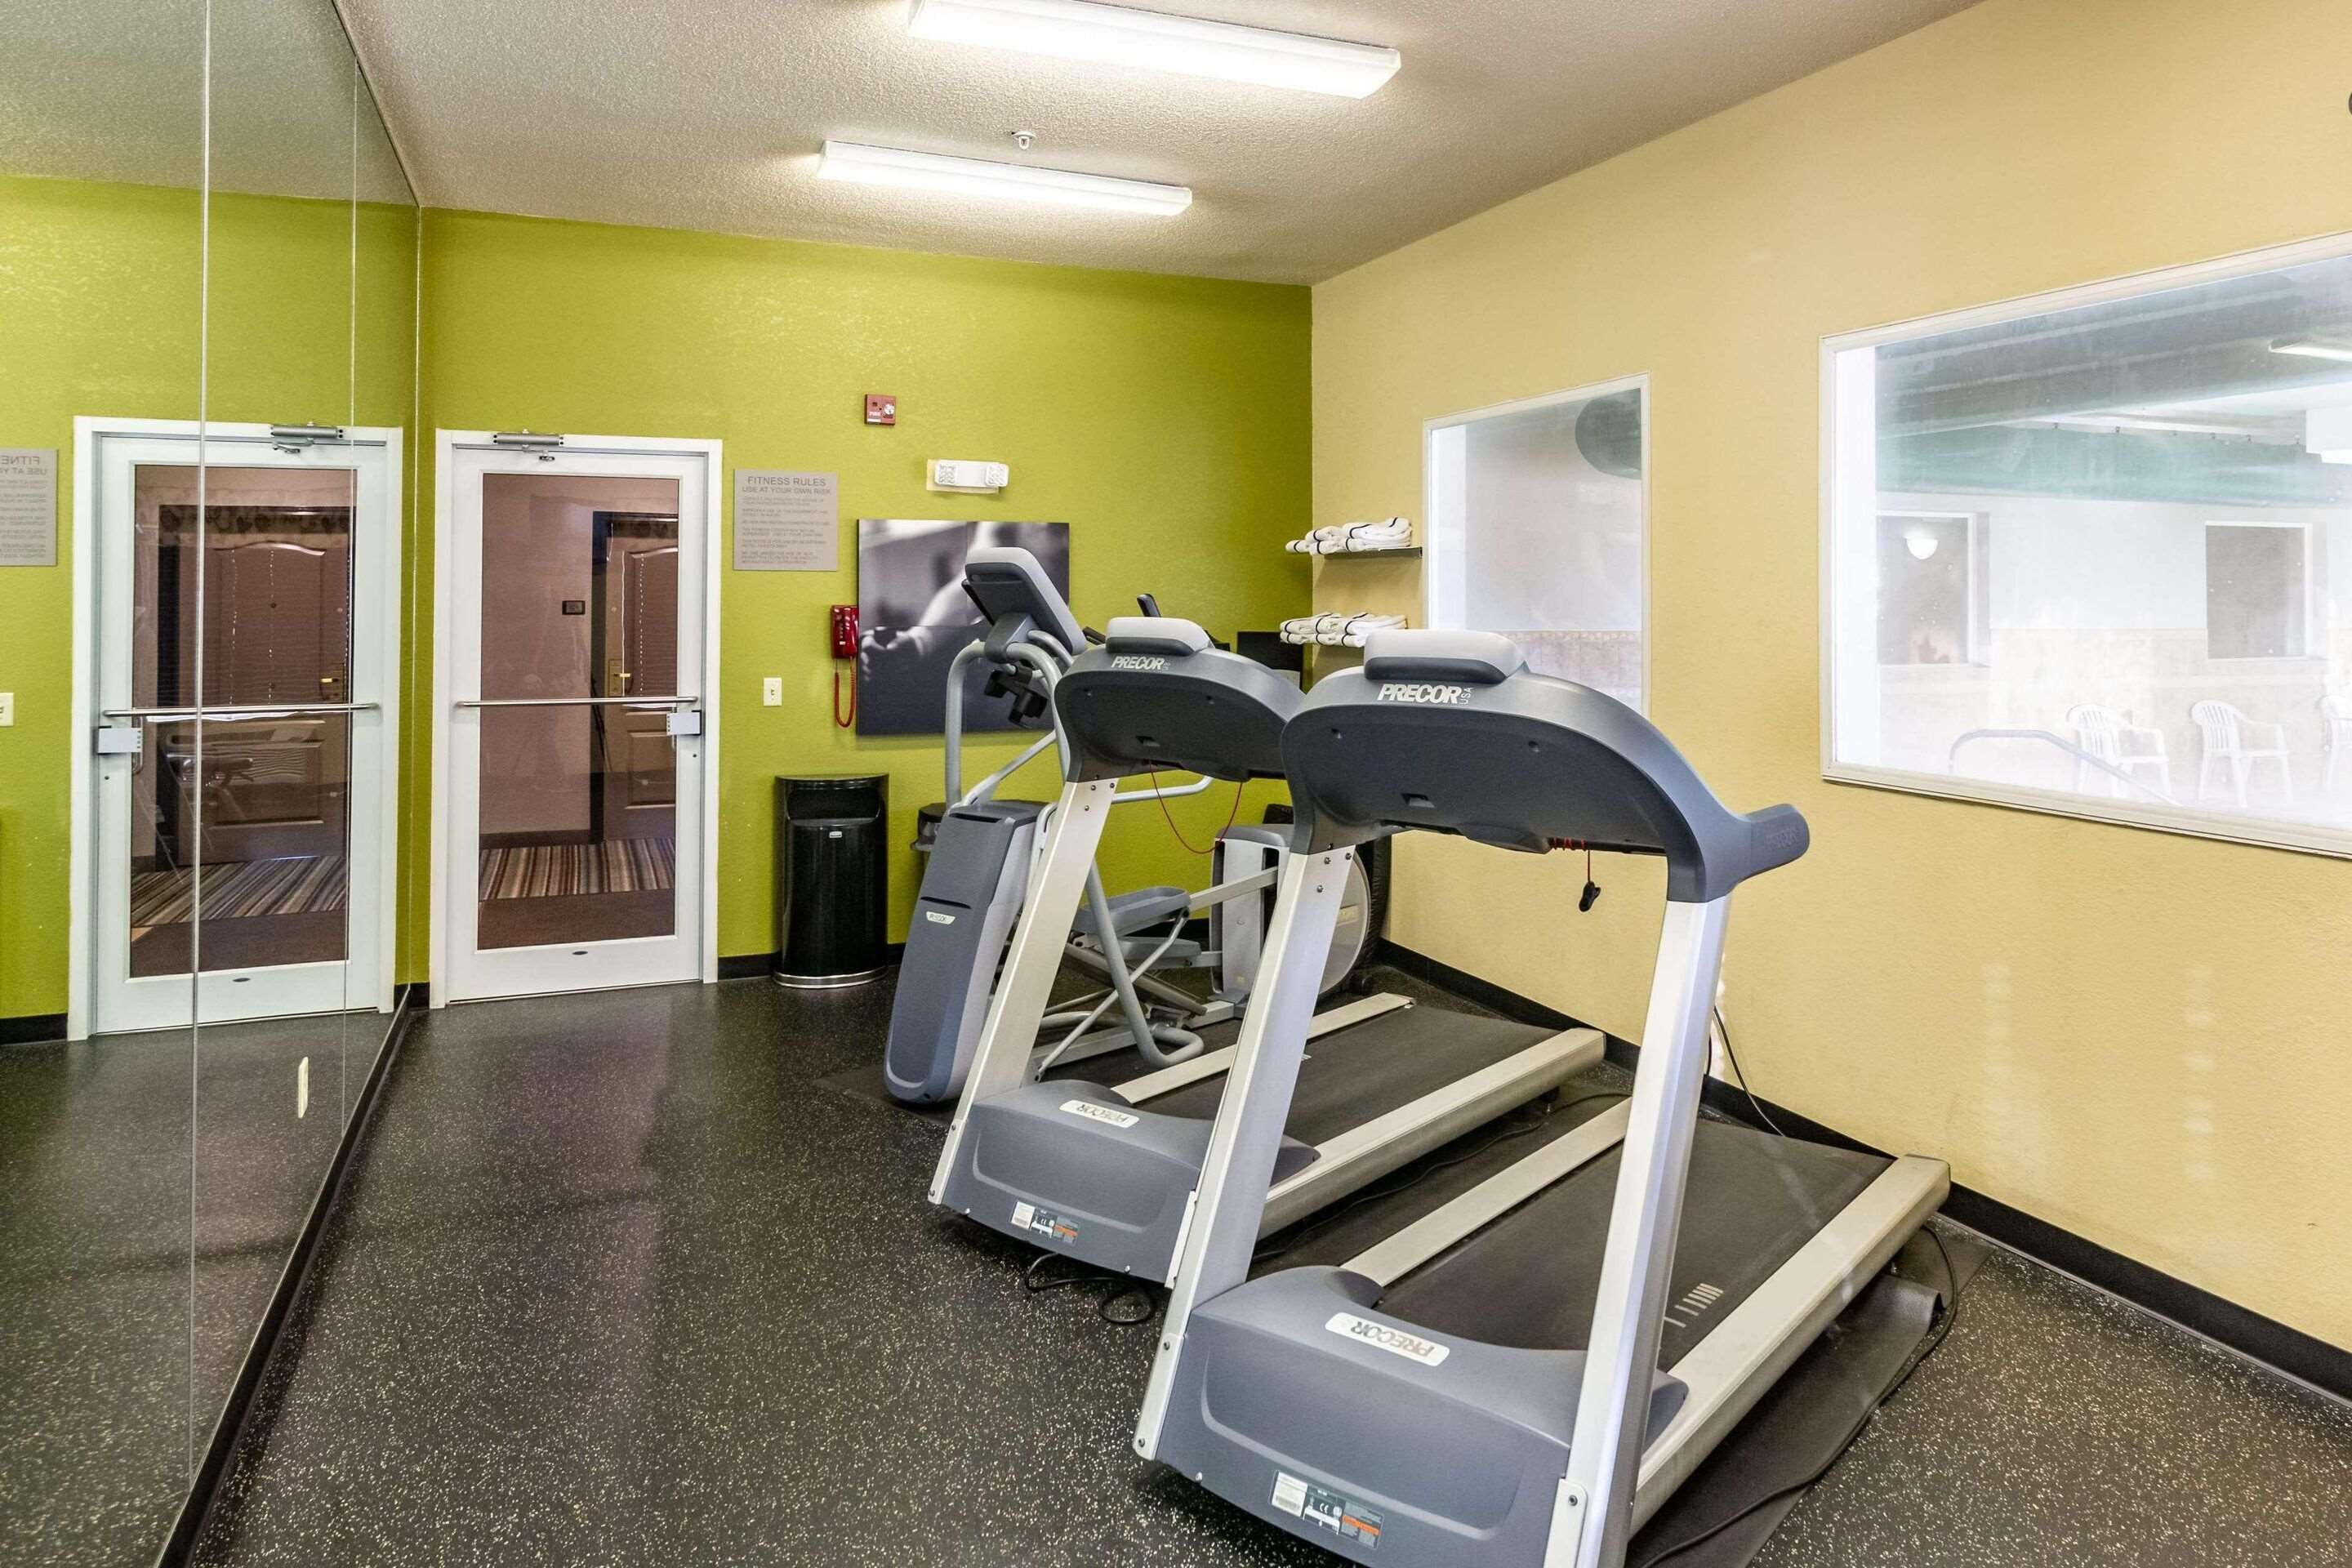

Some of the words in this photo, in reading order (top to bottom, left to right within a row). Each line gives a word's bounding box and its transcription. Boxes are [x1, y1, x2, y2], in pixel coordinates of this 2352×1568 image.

[747, 476, 791, 485] FITNESS
[793, 477, 826, 486] RULES
[1111, 656, 1165, 670] PRECOR
[1377, 684, 1462, 704] PRECOR
[1459, 687, 1474, 705] USA
[1351, 1321, 1435, 1356] PRECOR
